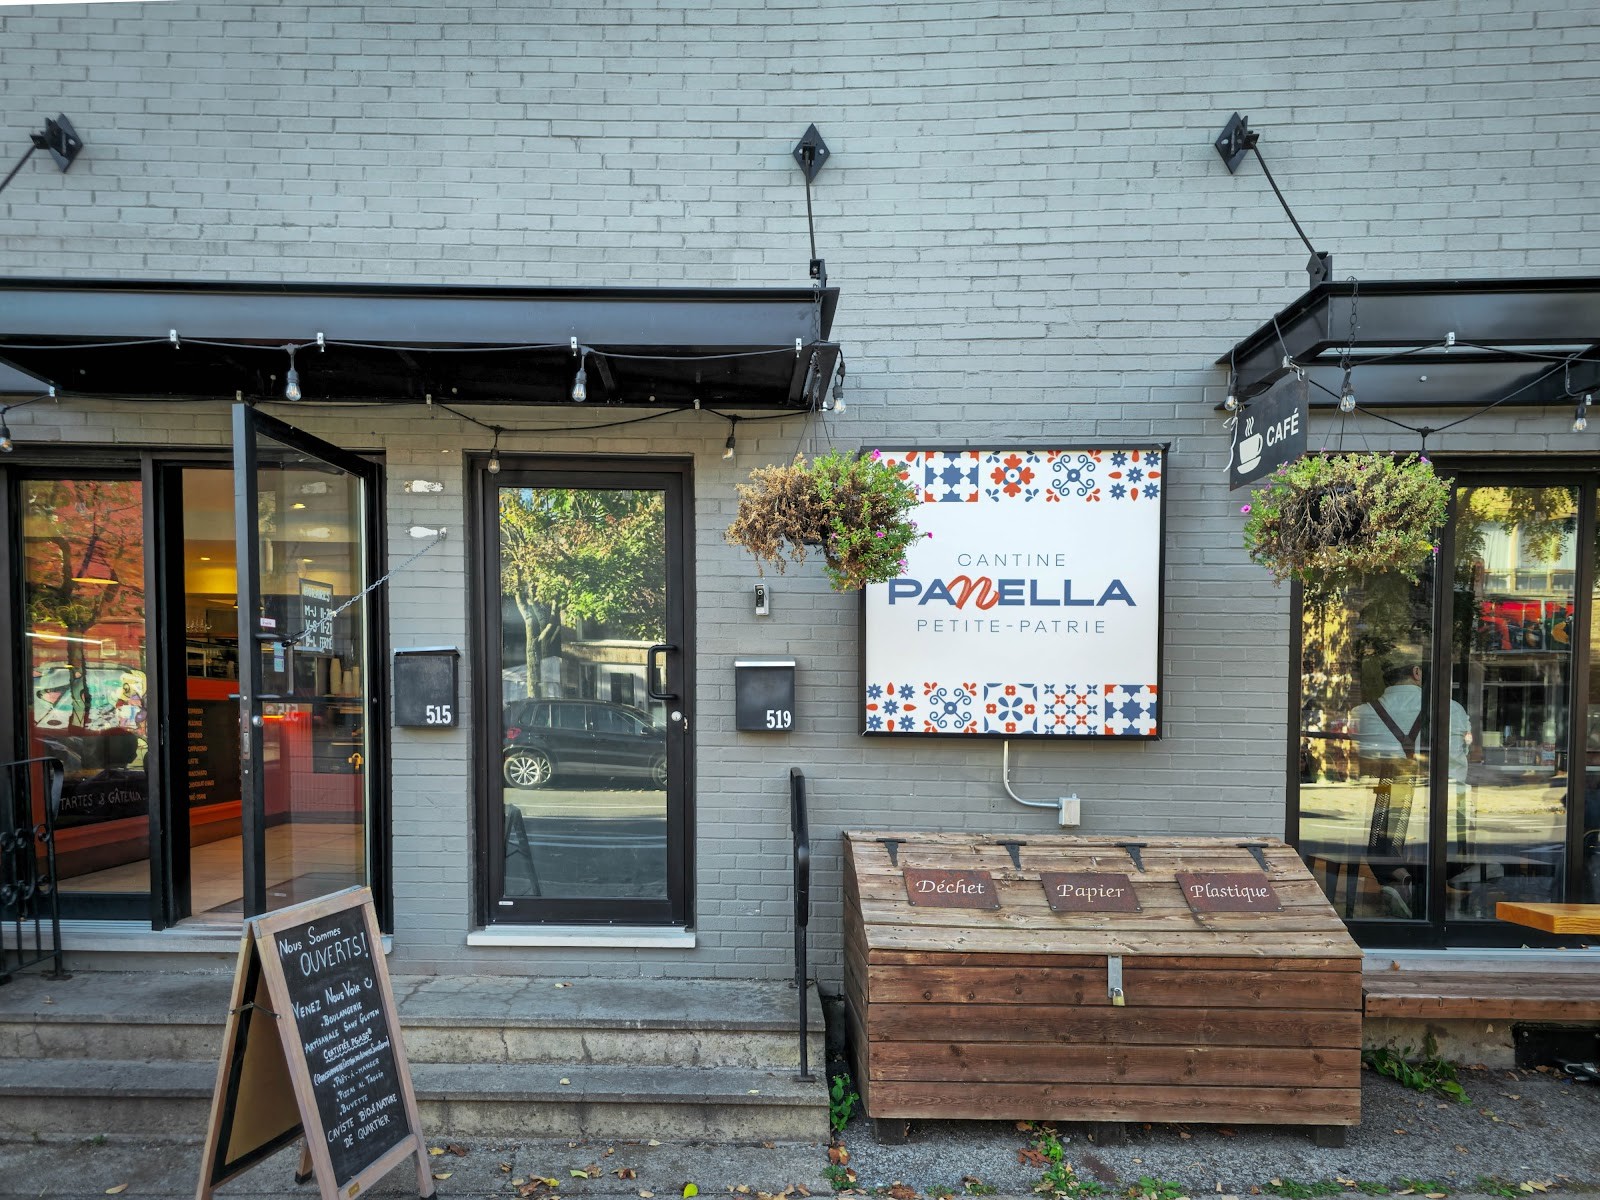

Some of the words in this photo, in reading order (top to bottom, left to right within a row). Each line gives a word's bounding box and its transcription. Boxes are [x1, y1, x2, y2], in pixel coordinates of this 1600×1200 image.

[1267, 408, 1299, 447] CAFÉ
[957, 553, 1066, 567] CANTINE
[917, 619, 1106, 634] PETITE-PATRIE
[426, 705, 451, 724] 515
[766, 709, 792, 729] 519
[915, 879, 984, 895] Déchet
[1057, 884, 1125, 903] Papier
[1190, 884, 1269, 903] Plastique
[279, 938, 302, 958] Nous
[307, 926, 341, 945] Sommes
[300, 932, 369, 977] OUVERTS!
[291, 999, 321, 1019] VENEZ
[343, 1133, 354, 1148] DE
[357, 1114, 390, 1140] QUARTIER
